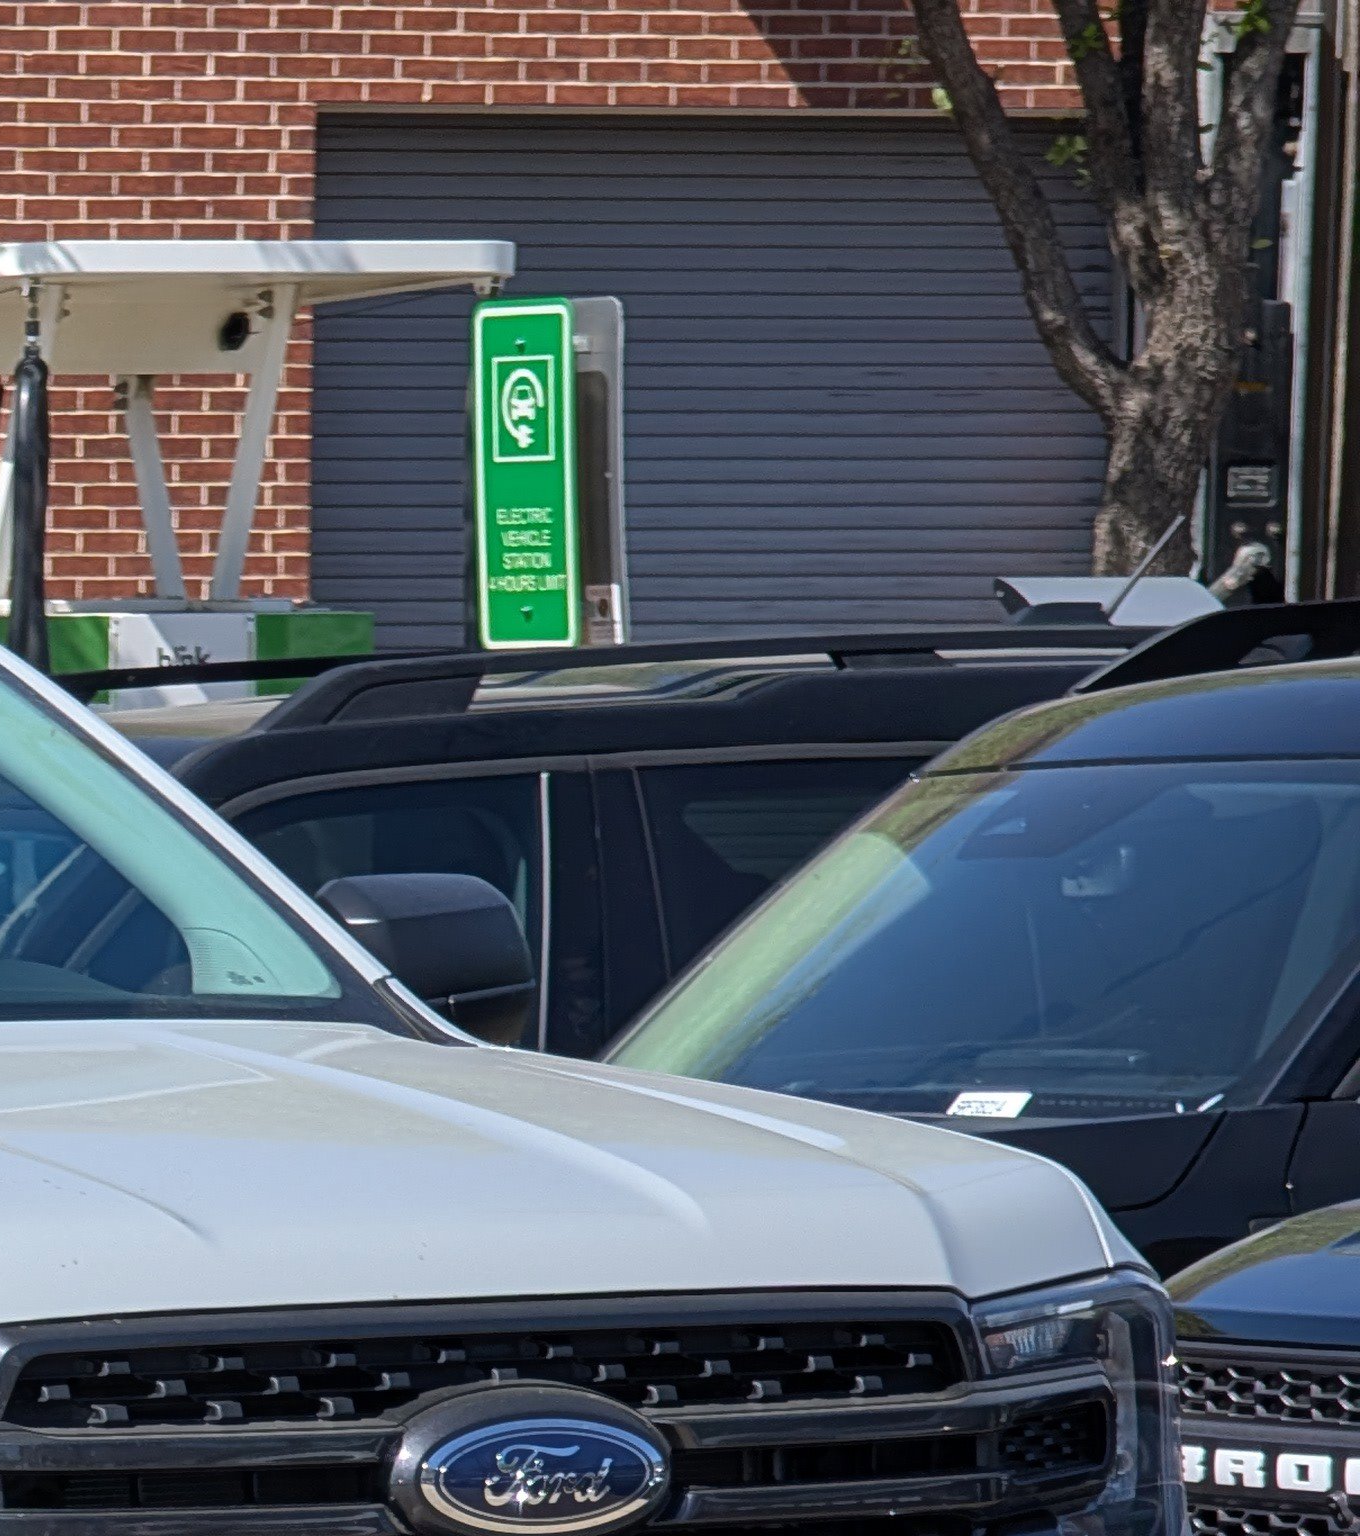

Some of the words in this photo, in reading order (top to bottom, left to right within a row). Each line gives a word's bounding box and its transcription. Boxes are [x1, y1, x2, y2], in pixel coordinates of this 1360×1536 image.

[496, 507, 553, 525] ELECTRIC
[501, 530, 552, 547] VEHICLE
[502, 552, 552, 569] STATION
[484, 1444, 613, 1507] Ford
[1181, 1444, 1360, 1495] BRO
